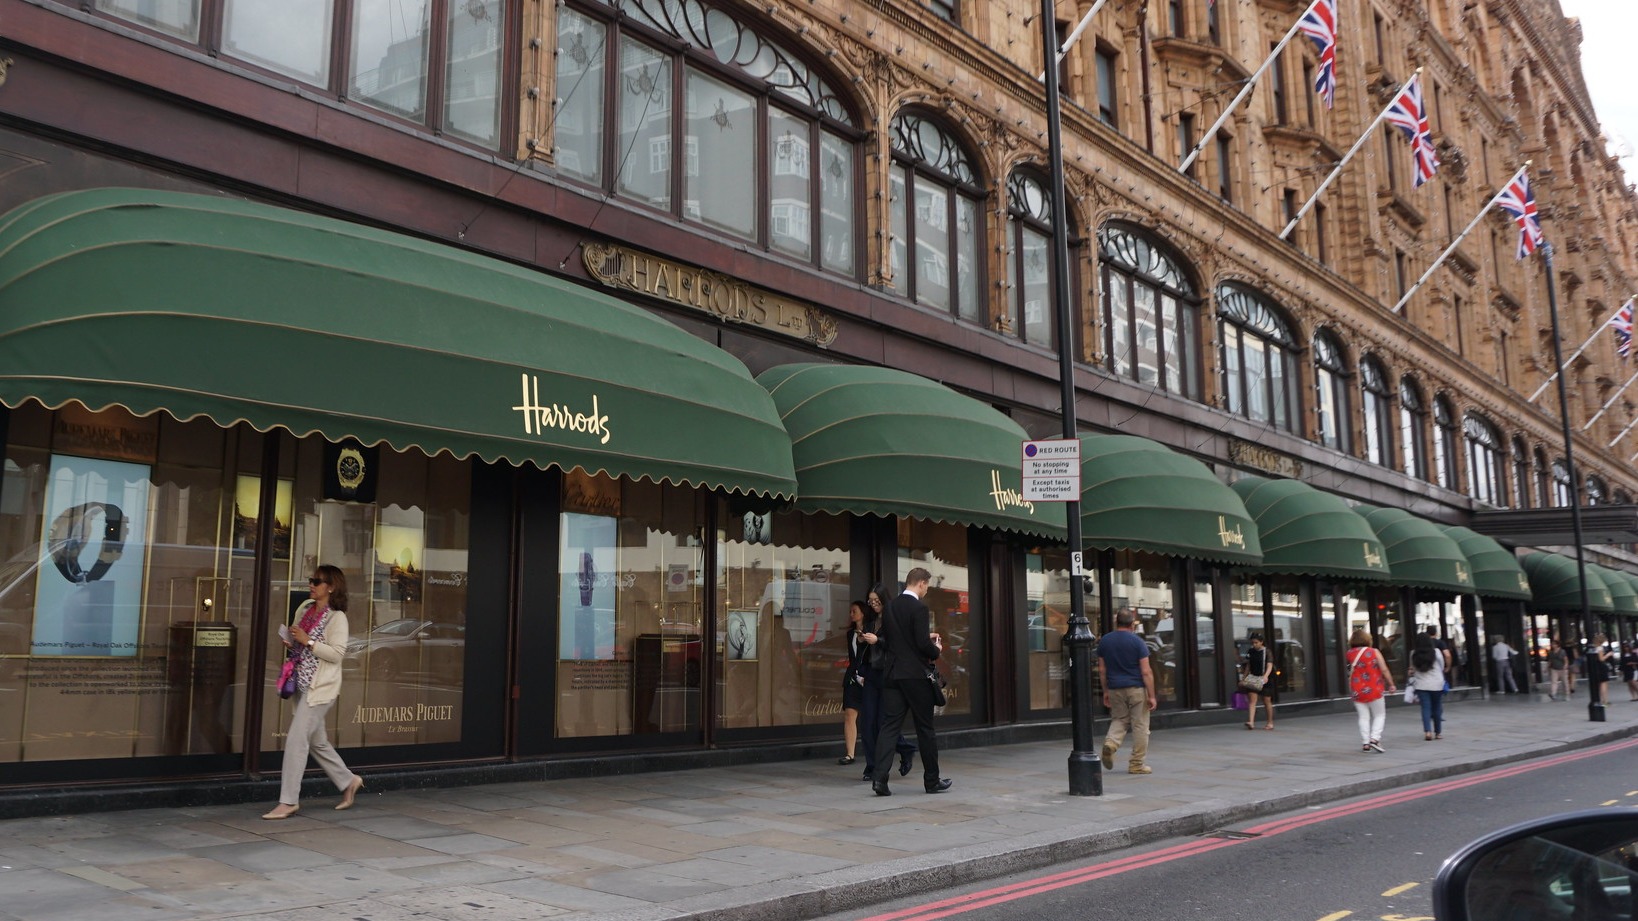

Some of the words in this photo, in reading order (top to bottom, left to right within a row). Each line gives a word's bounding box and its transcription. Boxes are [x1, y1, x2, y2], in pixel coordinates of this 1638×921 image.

[627, 254, 769, 325] HARRODS
[512, 373, 610, 444] Harrods
[1074, 554, 1081, 562] 6
[1076, 566, 1081, 574] 1
[352, 704, 413, 723] AUDEMARS
[416, 703, 453, 721] PIGUET
